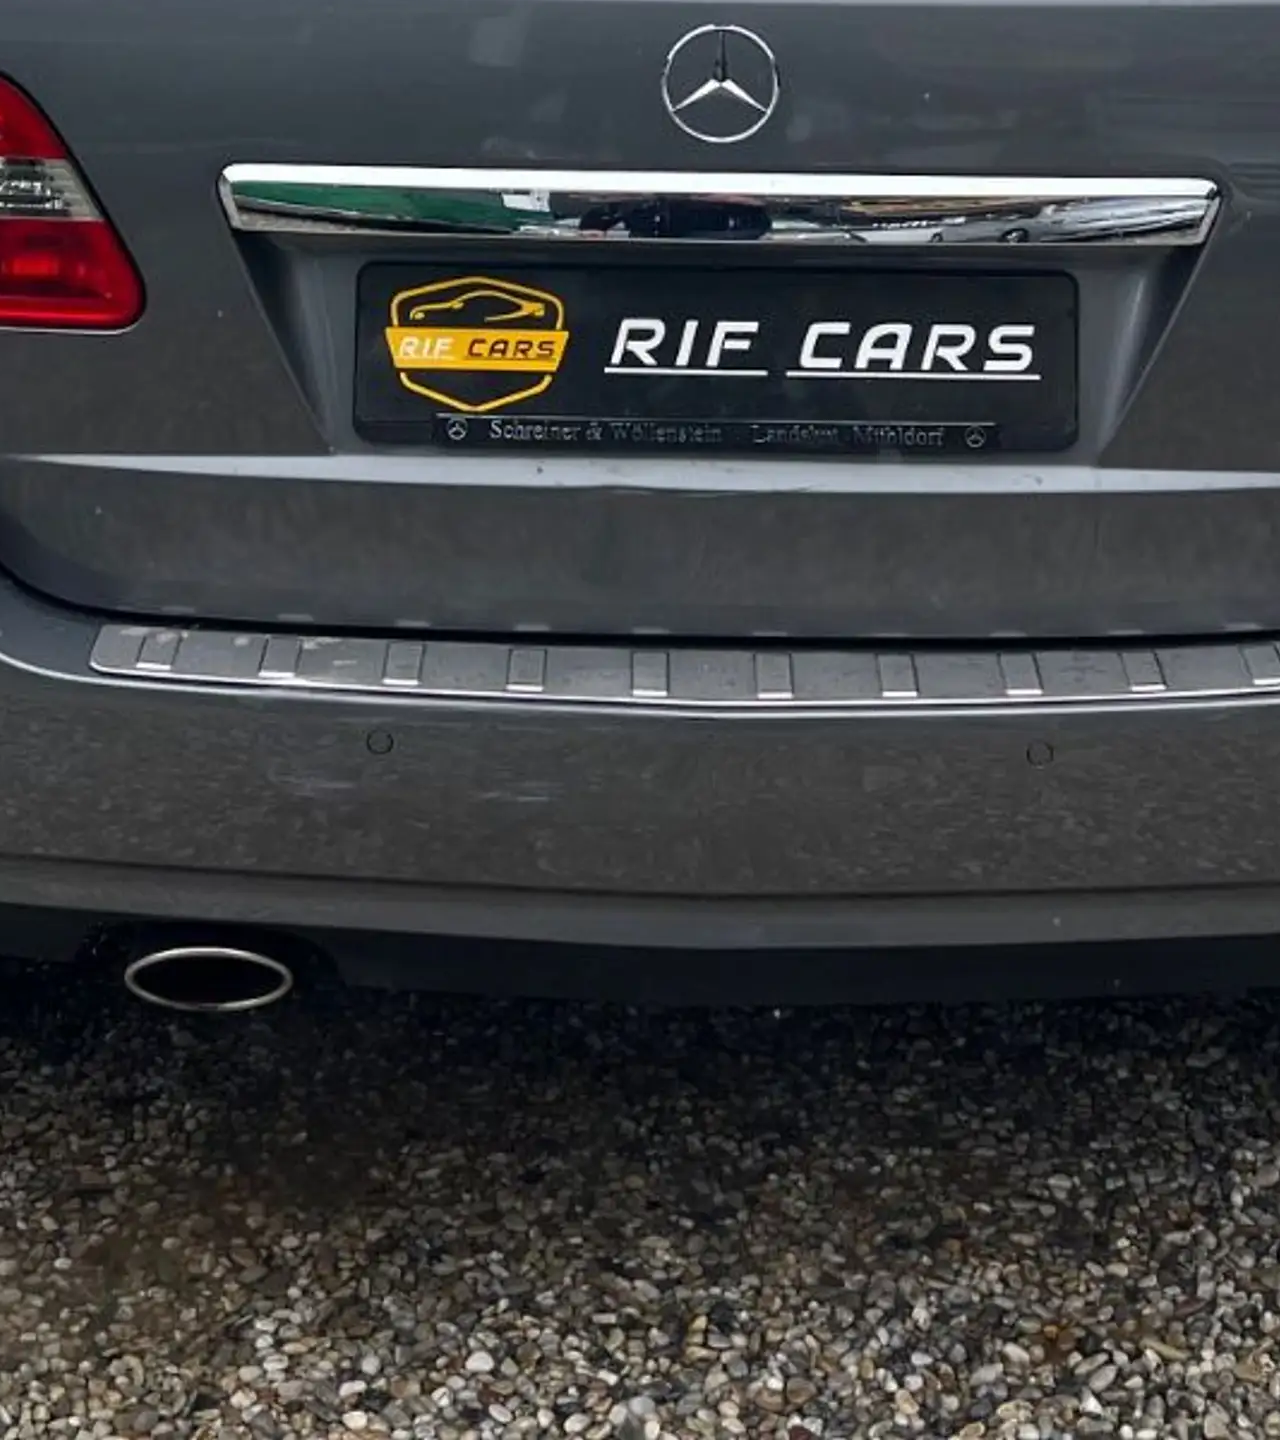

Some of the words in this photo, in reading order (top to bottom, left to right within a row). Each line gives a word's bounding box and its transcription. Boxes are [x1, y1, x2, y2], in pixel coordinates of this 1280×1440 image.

[399, 335, 456, 359] RIF
[466, 337, 558, 359] CARS
[610, 317, 760, 368] RIF
[799, 321, 1036, 371] CARS
[489, 418, 582, 441] Schreiner
